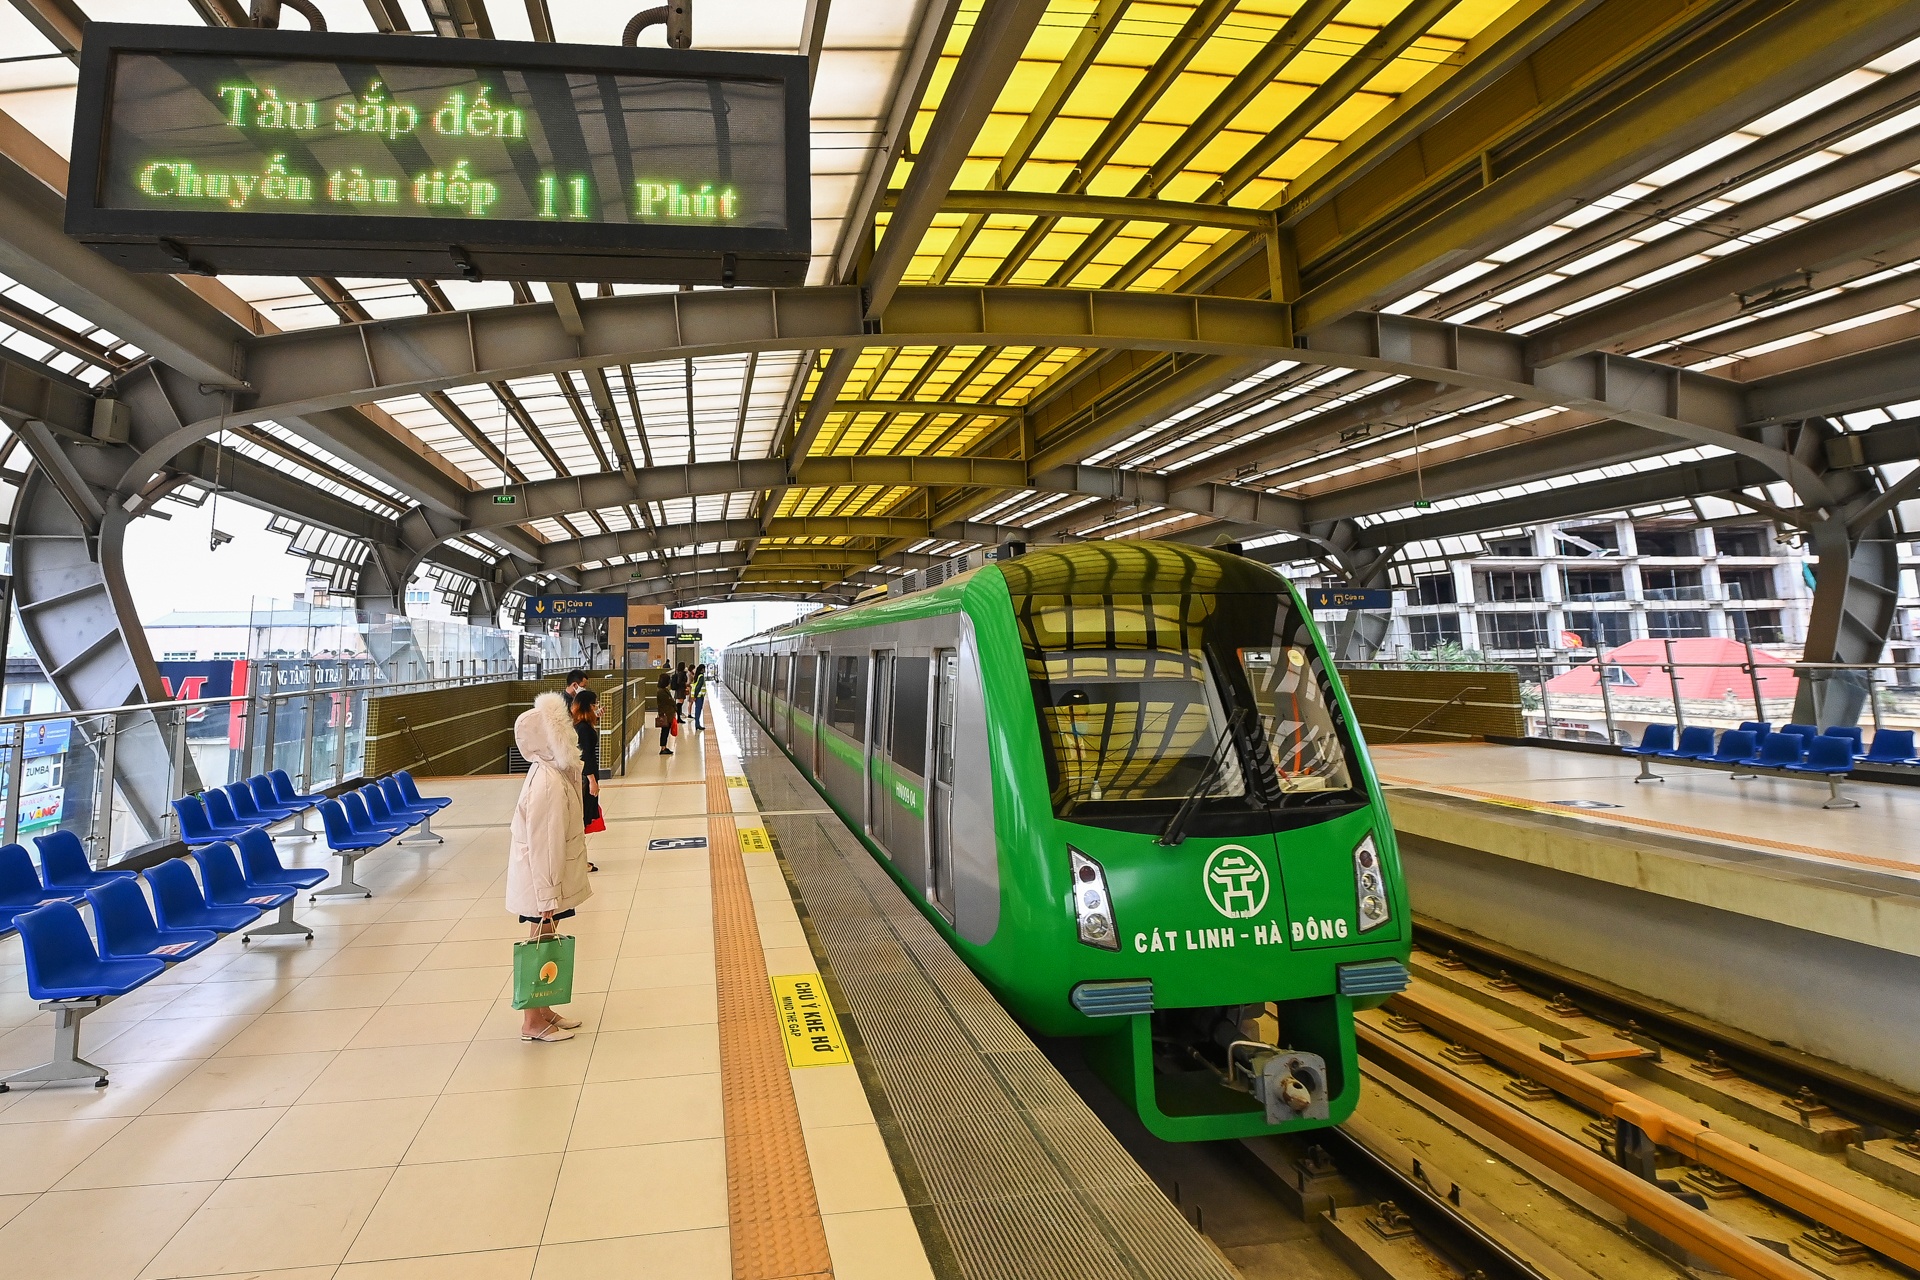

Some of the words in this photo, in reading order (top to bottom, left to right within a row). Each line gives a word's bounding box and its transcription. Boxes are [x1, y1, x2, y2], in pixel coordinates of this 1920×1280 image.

[217, 86, 317, 130] Tàu
[334, 81, 419, 140] sắp
[433, 86, 523, 138] đến
[139, 154, 313, 208] Chuyến
[328, 168, 398, 203] tàu
[413, 160, 498, 215] tiếp
[539, 176, 588, 218] 11
[635, 183, 737, 219] Phút
[260, 671, 288, 687] TRNG
[26, 765, 49, 777] ZUMBA
[1134, 927, 1178, 953] CÁT
[1185, 927, 1235, 950] LINH
[1254, 919, 1283, 945] HÀ
[1291, 916, 1348, 942] ĐÔNG
[794, 982, 818, 1000] CHÚ
[782, 996, 794, 1010] MIND
[786, 1011, 798, 1022] THE
[803, 1012, 826, 1033] KHE
[789, 1023, 802, 1037] GAP
[810, 1036, 840, 1052] HỞ
